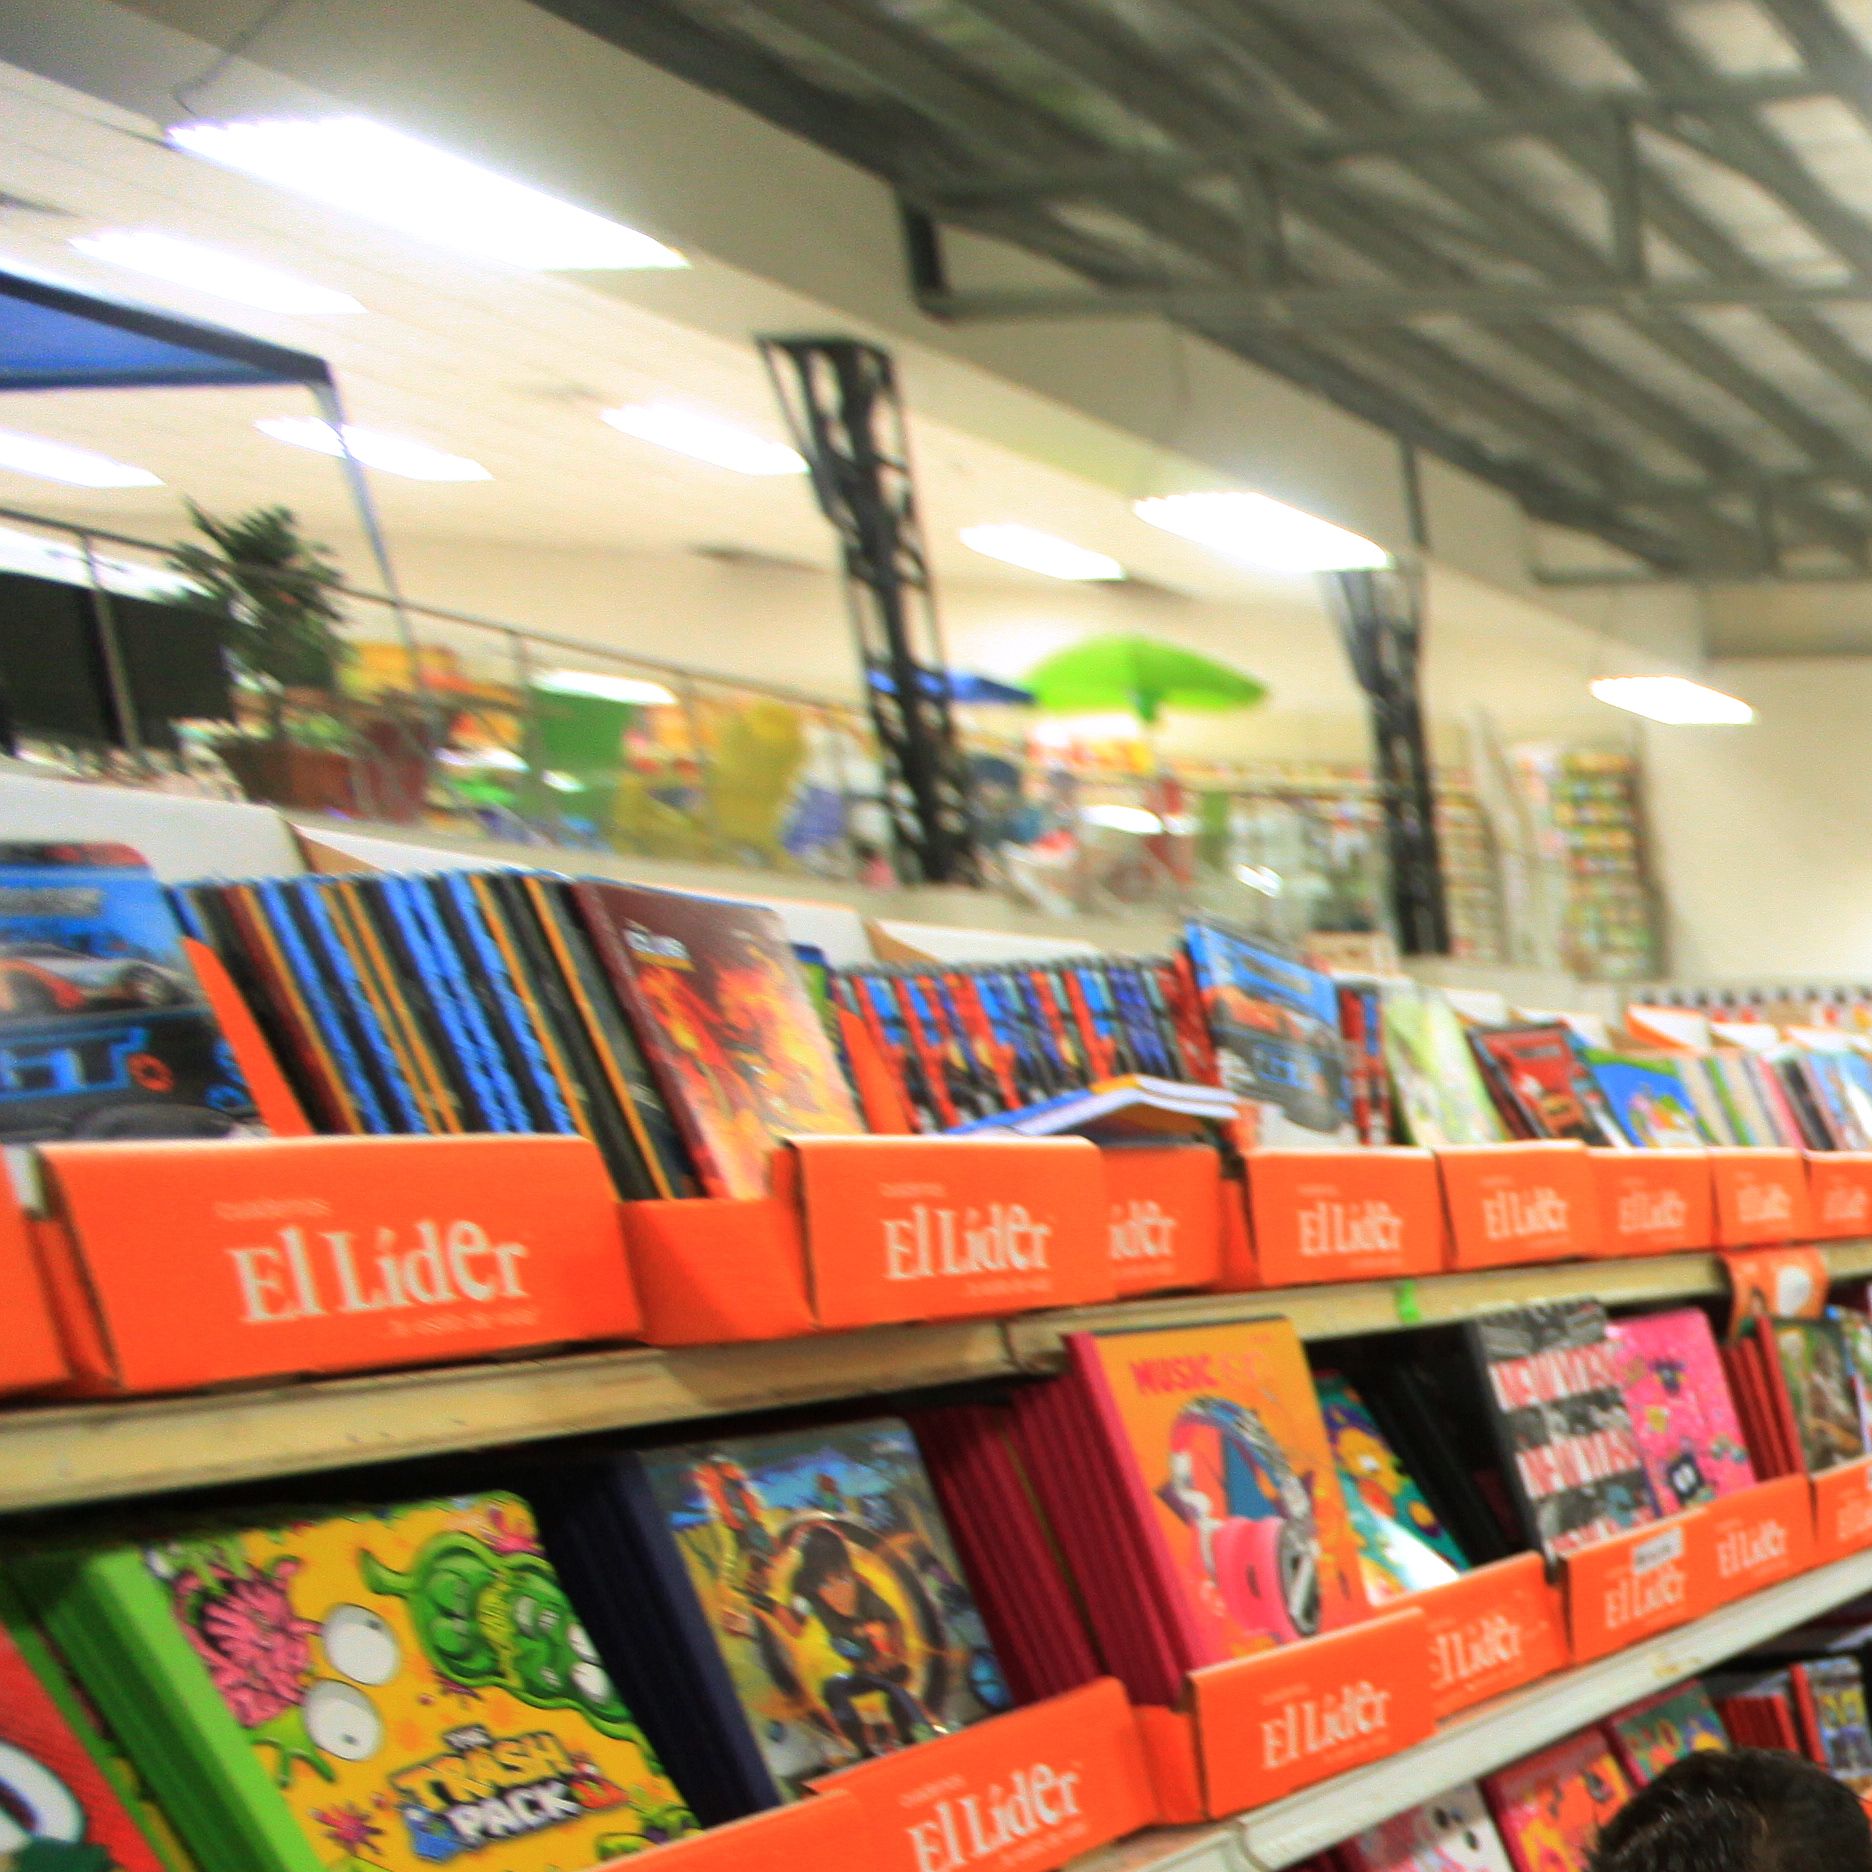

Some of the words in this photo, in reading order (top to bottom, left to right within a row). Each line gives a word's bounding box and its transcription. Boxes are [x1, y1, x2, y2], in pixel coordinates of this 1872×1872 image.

[227, 1226, 322, 1325] El
[390, 1733, 570, 1810] TRASH
[445, 1780, 582, 1848] PACK
